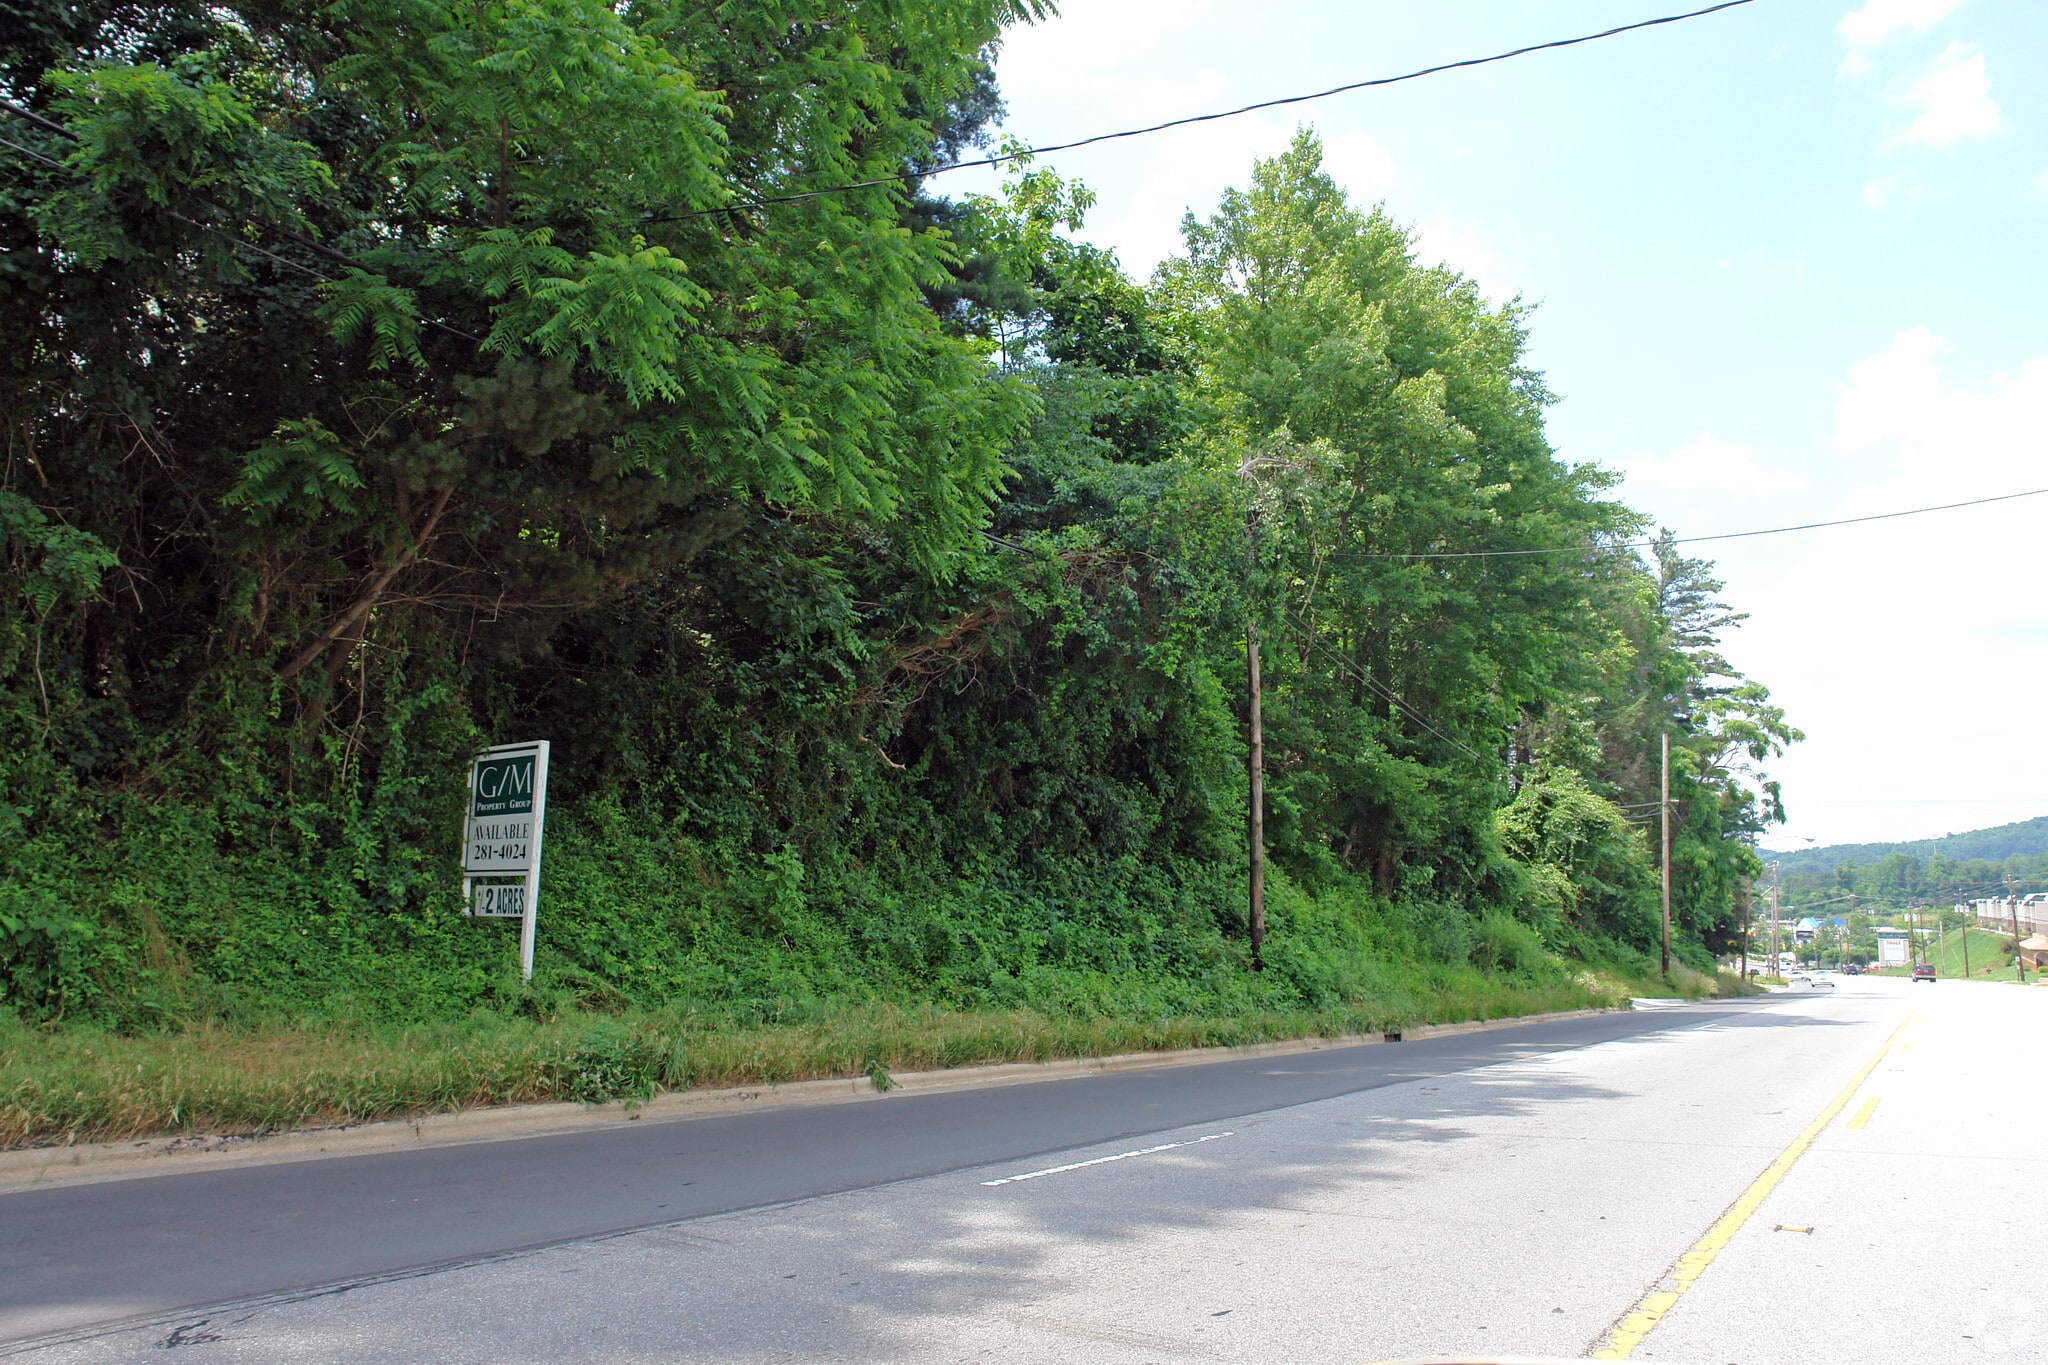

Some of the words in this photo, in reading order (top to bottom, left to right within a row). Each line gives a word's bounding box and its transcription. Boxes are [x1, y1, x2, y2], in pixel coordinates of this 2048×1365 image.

[479, 762, 532, 798] G/M
[509, 799, 532, 809] GROUP
[474, 822, 530, 841] AVAILABLE
[474, 843, 527, 860] 281-4024
[496, 887, 525, 915] ACRES
